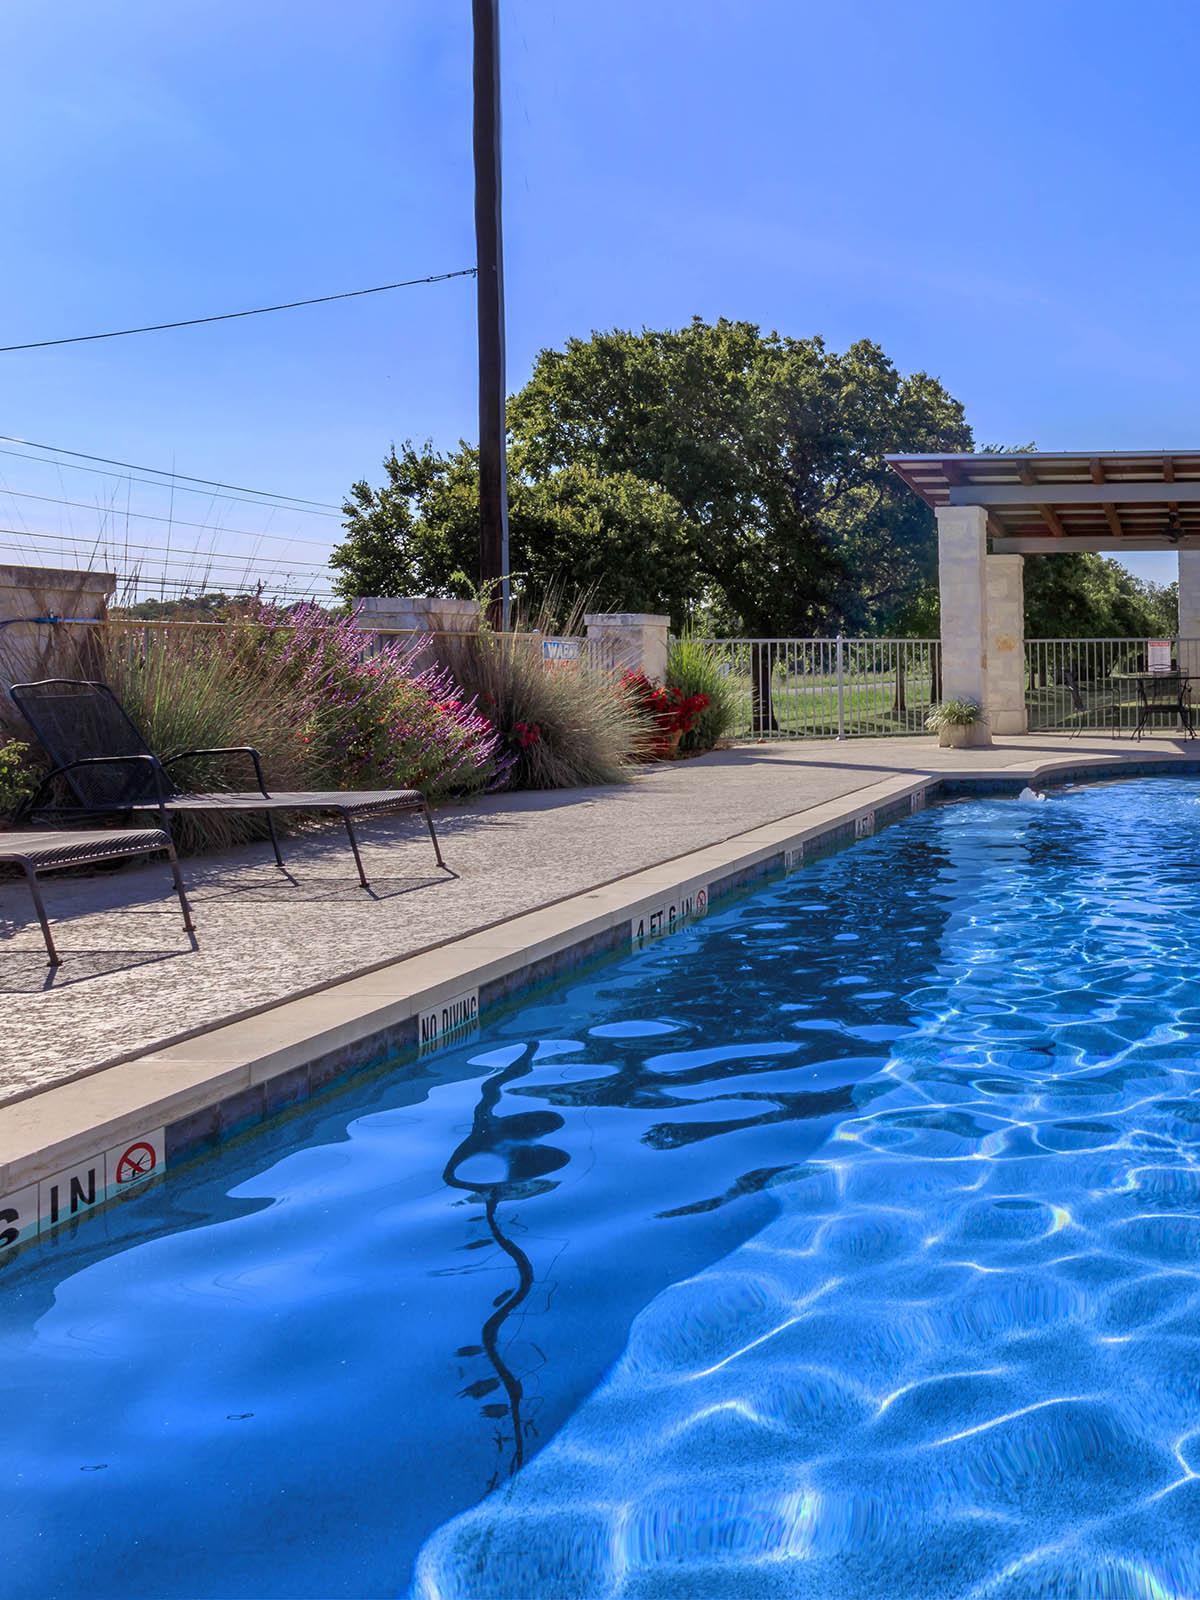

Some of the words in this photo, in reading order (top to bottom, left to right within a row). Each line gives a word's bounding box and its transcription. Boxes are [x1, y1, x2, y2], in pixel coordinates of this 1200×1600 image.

[650, 910, 663, 936] FT
[681, 897, 693, 916] IN
[422, 1013, 437, 1042] NO
[442, 996, 477, 1034] DIVING
[51, 1168, 96, 1224] IN
